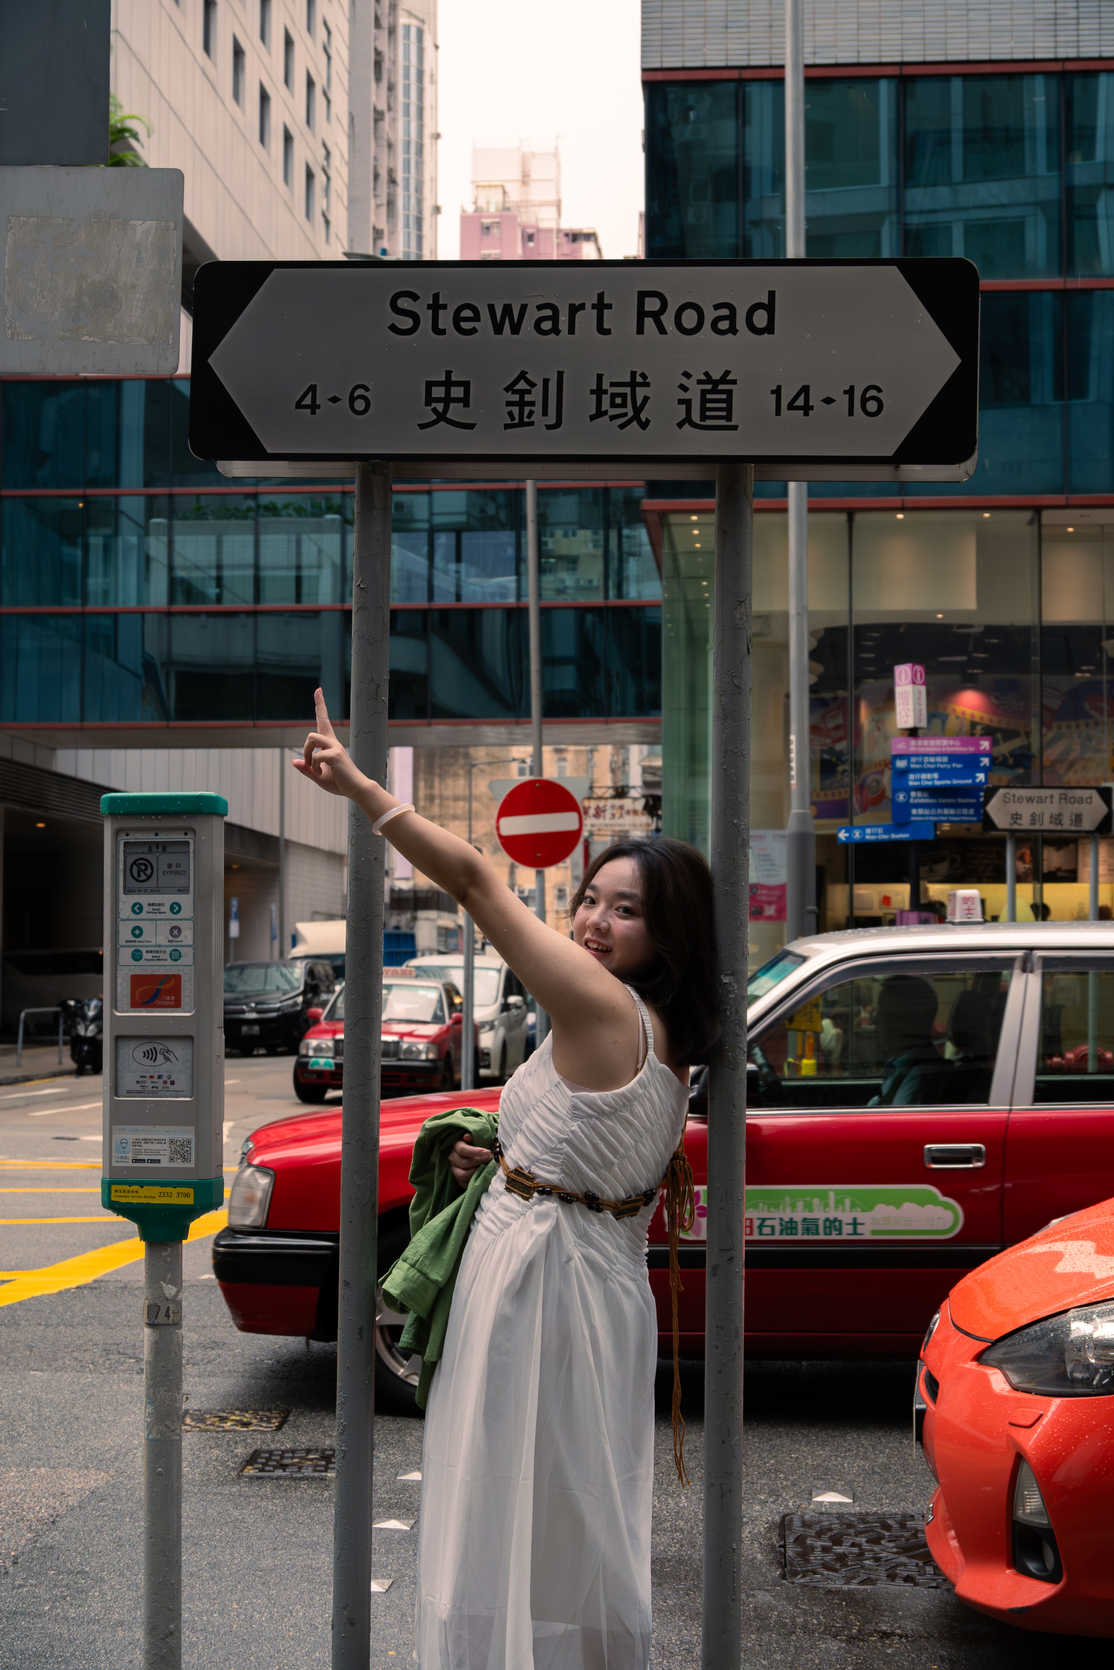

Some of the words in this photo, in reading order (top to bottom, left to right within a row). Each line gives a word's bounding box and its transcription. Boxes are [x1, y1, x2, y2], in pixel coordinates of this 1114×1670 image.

[387, 290, 613, 337] Stewart
[636, 290, 776, 337] Road
[416, 369, 739, 431] 史釗域道
[1003, 792, 1054, 805] Stewart
[1059, 793, 1094, 806] Road
